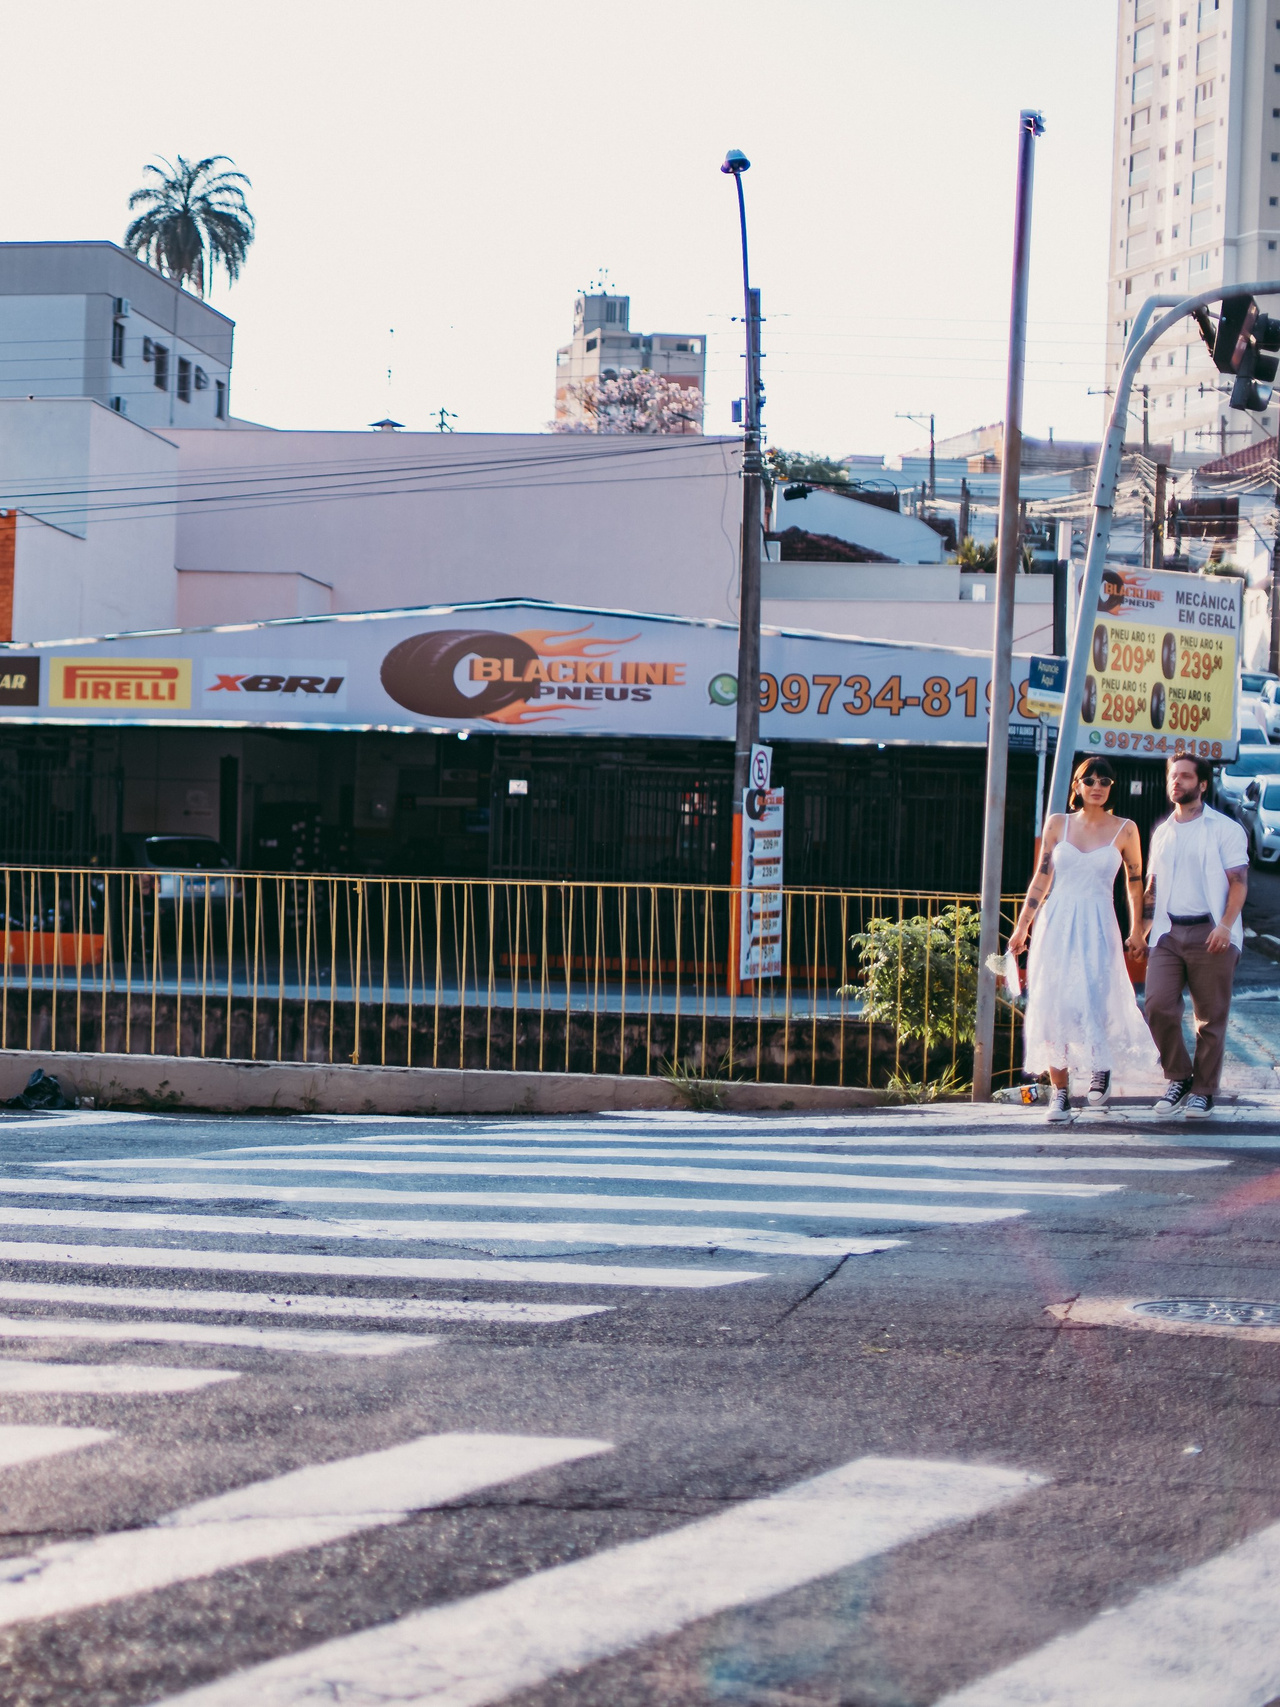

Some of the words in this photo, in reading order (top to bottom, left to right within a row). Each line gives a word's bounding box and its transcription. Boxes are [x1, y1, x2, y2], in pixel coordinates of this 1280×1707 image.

[1104, 582, 1164, 602] BLACKLINE
[1176, 590, 1236, 612] MECÂNICA
[1121, 598, 1155, 609] PNEUS
[1178, 609, 1195, 625] EM
[1198, 611, 1236, 629] GERAL
[1110, 628, 1129, 640] PNEU
[1131, 630, 1146, 643] ARO
[1147, 633, 1156, 644] 13
[1180, 635, 1198, 648] PNEU
[1200, 638, 1214, 650] ARO
[1215, 640, 1223, 651] 14
[469, 657, 687, 685] BLACKLINE
[1037, 661, 1060, 674] Anuncie
[62, 665, 179, 701] PIRELLI
[205, 674, 345, 694] XBRI
[1040, 674, 1054, 688] Aqui
[1101, 678, 1120, 690] PNEU
[1122, 680, 1137, 692] ARO
[1138, 682, 1147, 693] 15
[532, 685, 652, 702] PNEUS
[1168, 687, 1186, 700] PNEU
[1187, 689, 1202, 702] ARO
[1203, 691, 1211, 702] 16
[1104, 730, 1223, 758] 99734-8198
[757, 758, 765, 780] E
